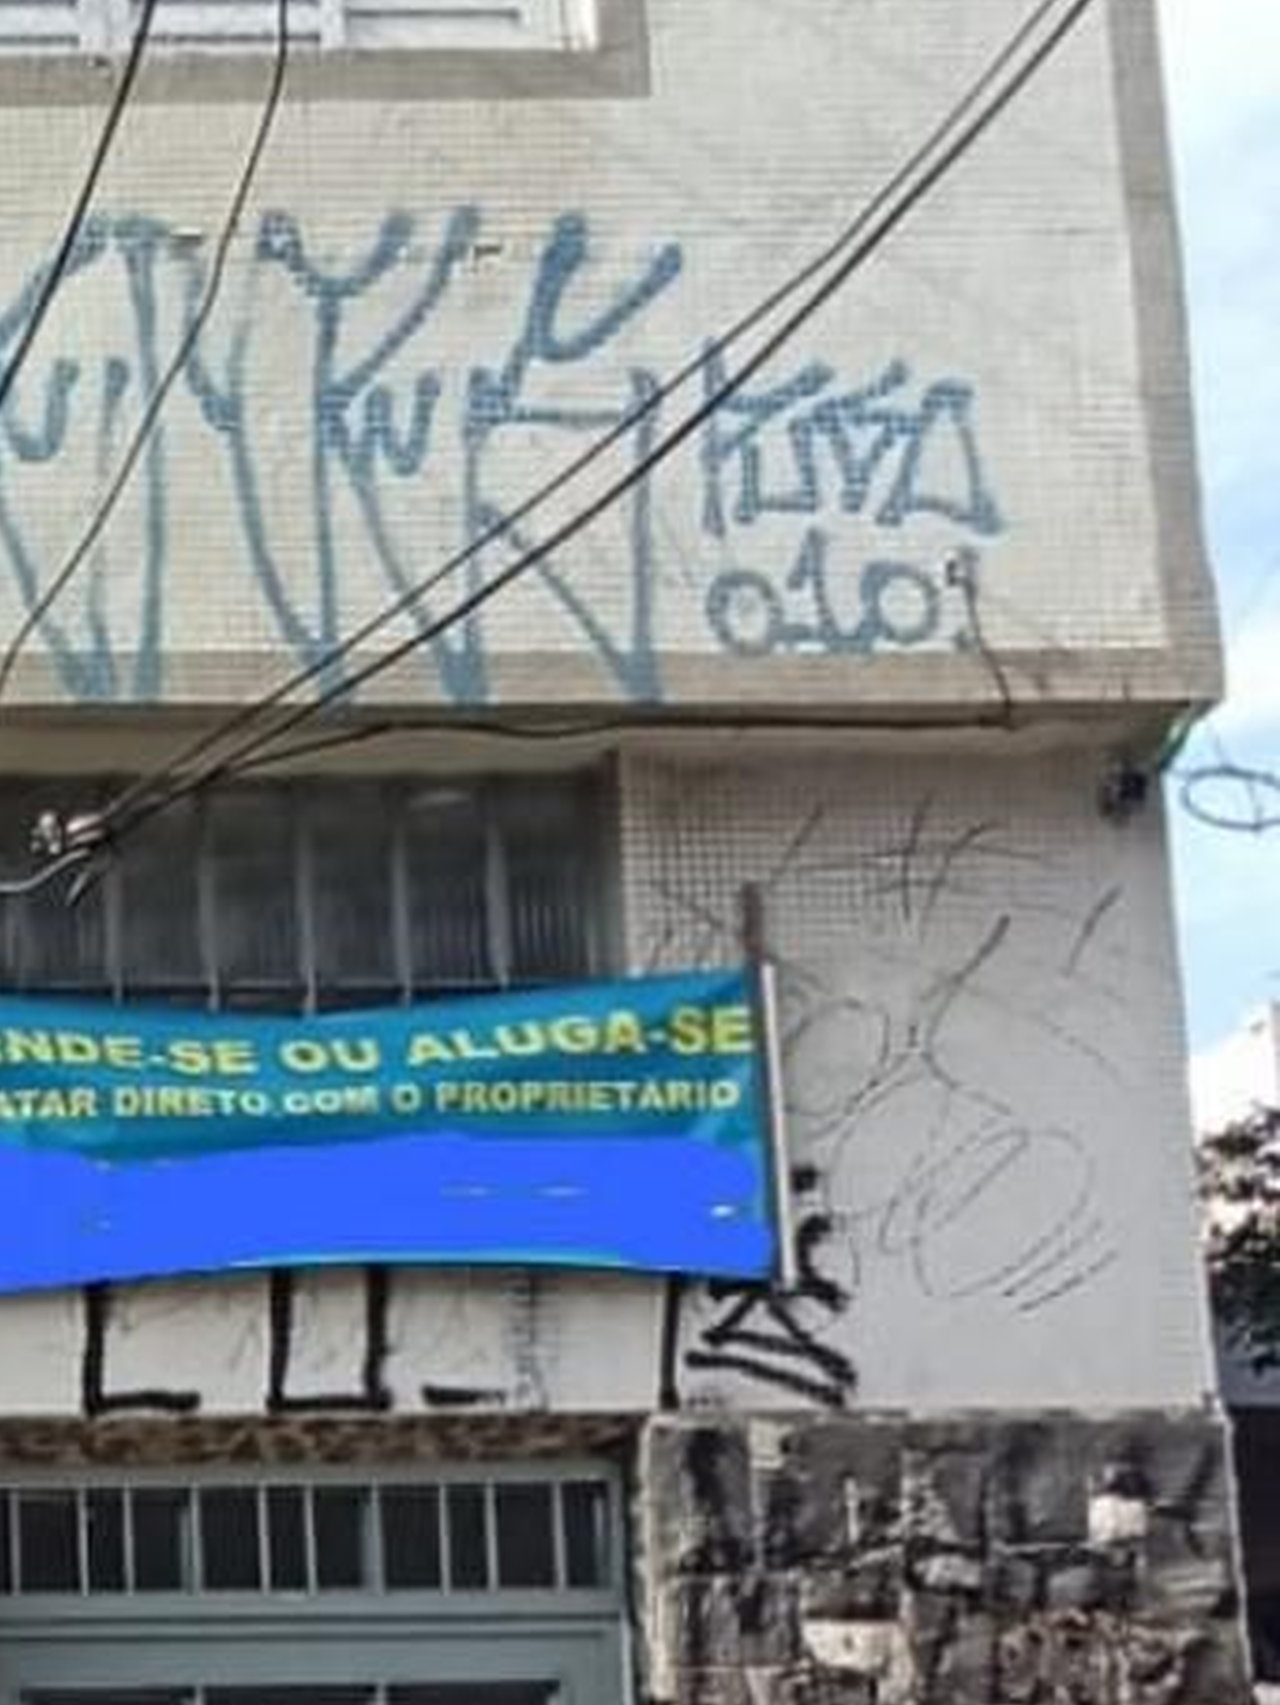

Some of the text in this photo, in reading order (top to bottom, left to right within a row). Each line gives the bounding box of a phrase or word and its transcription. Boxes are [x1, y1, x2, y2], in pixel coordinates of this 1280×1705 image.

[279, 1038, 381, 1073] OU
[407, 1005, 754, 1068] ALUGA-SE
[114, 1086, 270, 1118] DIRETO
[283, 1085, 380, 1116] COM
[392, 1083, 422, 1114] O
